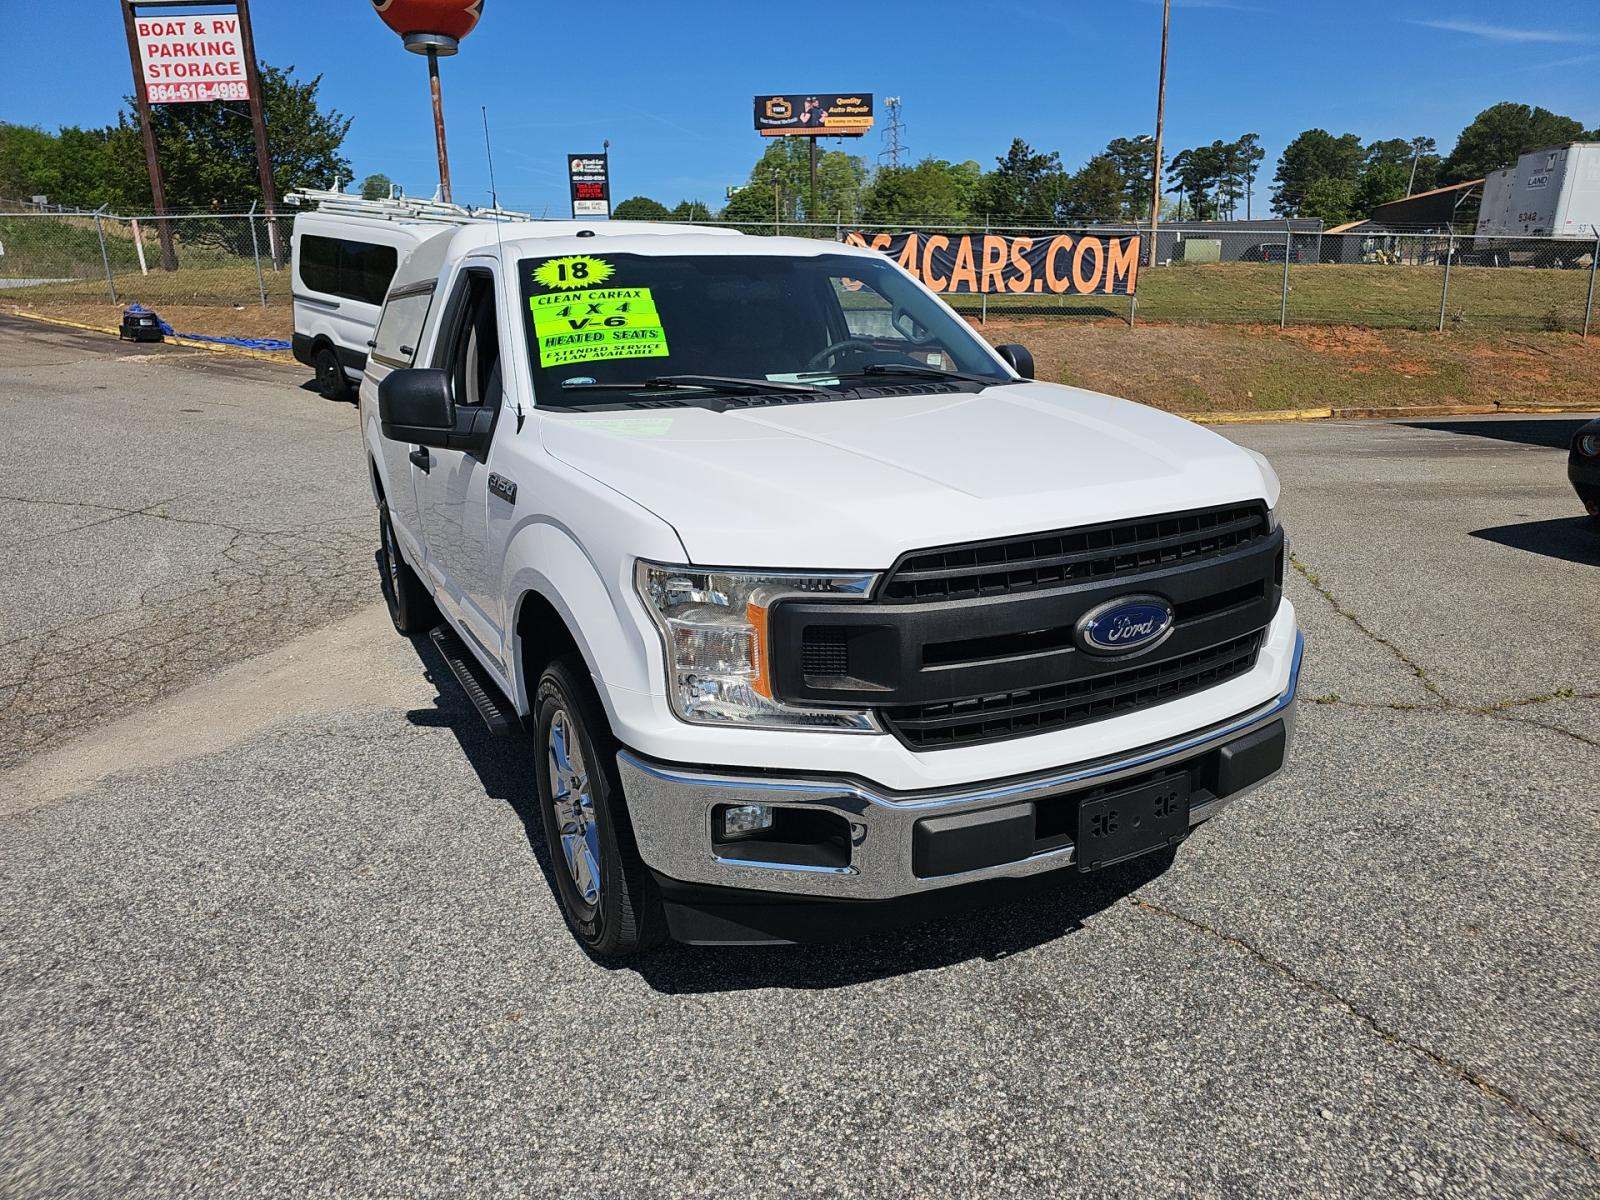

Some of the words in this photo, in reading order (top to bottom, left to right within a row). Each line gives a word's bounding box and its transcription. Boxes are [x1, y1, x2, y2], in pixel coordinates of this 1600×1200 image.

[138, 22, 186, 37] BOAT
[193, 21, 206, 35] &
[212, 20, 236, 34] RV
[147, 41, 236, 58] PARKING
[148, 61, 241, 78] STORAGE
[149, 82, 248, 101] 864-616-4989
[836, 97, 862, 106] Quality
[846, 105, 869, 114] Repair
[557, 262, 589, 281] 18
[845, 232, 1141, 294] 4CARS.COM
[537, 293, 582, 305] CLEAN
[589, 290, 642, 300] CARFAX
[556, 305, 571, 317] 4
[615, 301, 631, 312] 4
[568, 316, 627, 330] V-6
[545, 333, 605, 348] HEATED
[612, 329, 659, 340] SEATS
[546, 346, 609, 359] EXTENDED
[555, 353, 587, 363] PLAN
[592, 350, 654, 358] AVAILABLE
[1108, 616, 1155, 641] Ford
